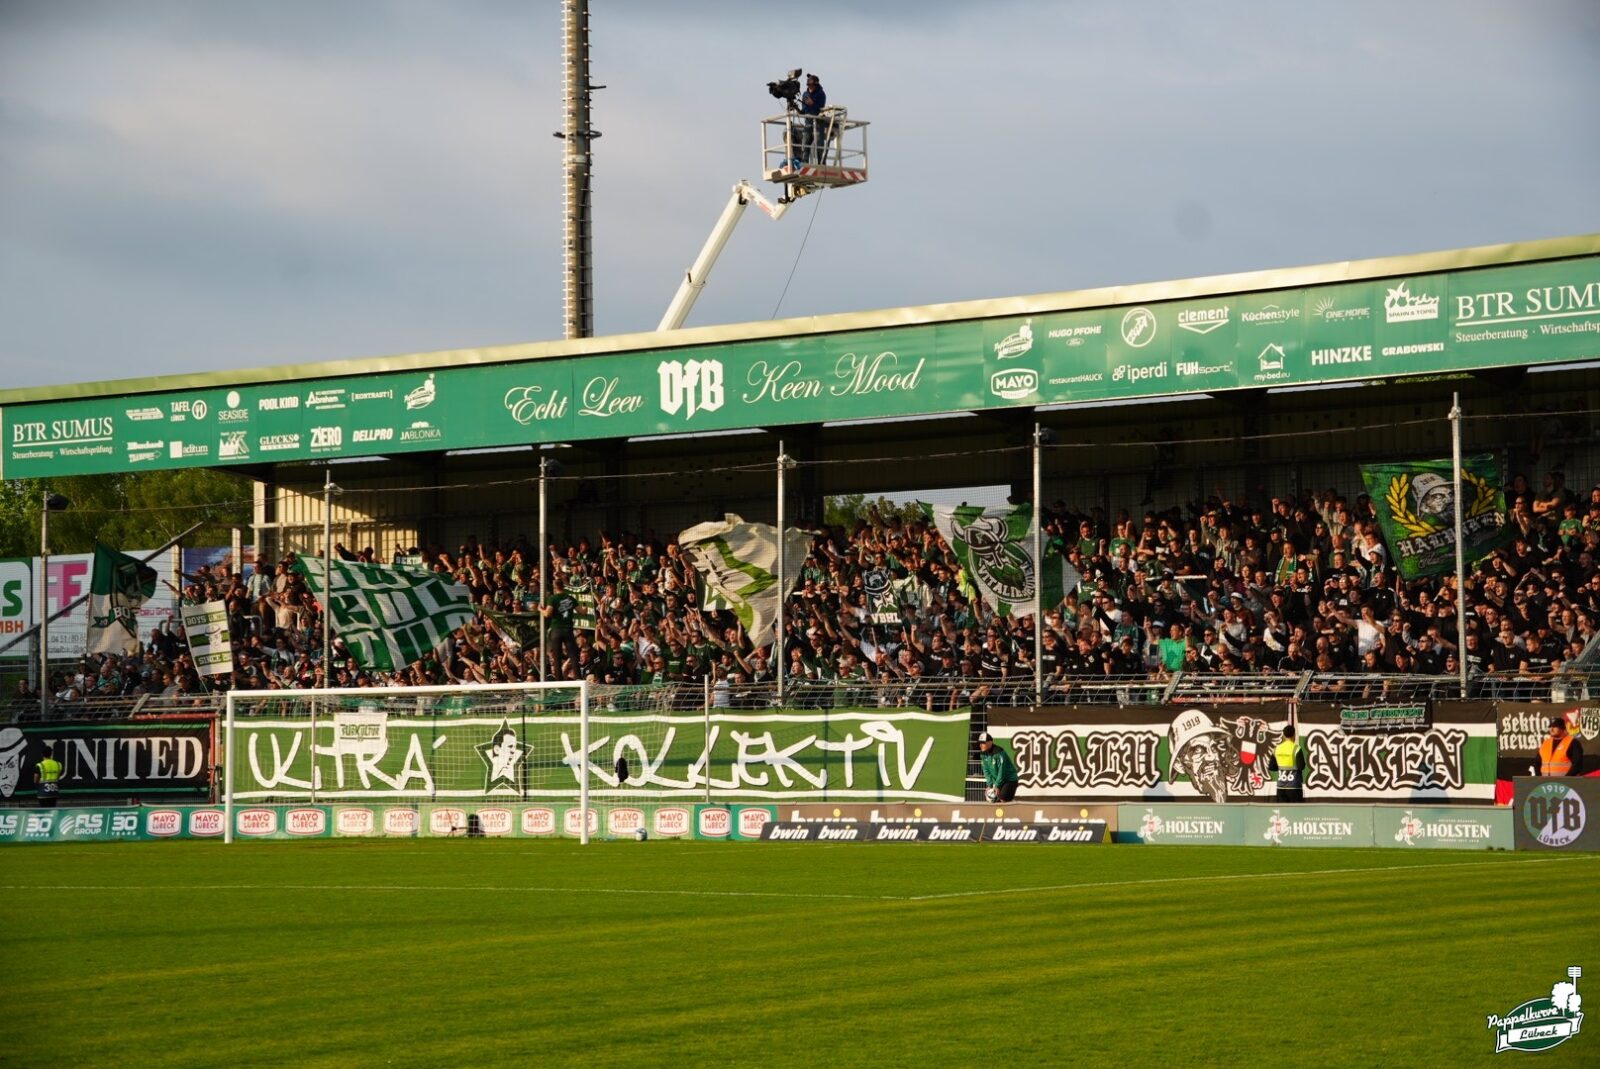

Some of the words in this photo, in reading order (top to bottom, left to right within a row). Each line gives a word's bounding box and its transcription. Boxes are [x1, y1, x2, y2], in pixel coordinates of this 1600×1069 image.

[1456, 292, 1516, 320] BTR
[1526, 283, 1600, 314] SUM
[1178, 306, 1229, 322] clement
[1049, 330, 1072, 338] HUGO
[1455, 329, 1528, 343] Steuerberatung
[1540, 322, 1600, 335] Wirtschaftsp
[1311, 345, 1372, 366] HINZKE
[1382, 343, 1444, 357] GRABOWSKI
[742, 360, 823, 403] Keen
[830, 351, 925, 397] Mood
[1127, 361, 1168, 383] iperdi
[995, 374, 1034, 390] MAYO
[171, 401, 190, 412] TAFEL
[504, 385, 567, 425] Echt
[577, 376, 644, 418] Leev
[218, 409, 248, 420] SEASIDE
[13, 422, 47, 442] BTR
[52, 417, 113, 440] SUMUS
[352, 428, 394, 442] DELLPRO
[400, 429, 441, 440] JABLONKA
[185, 615, 207, 626] BOYS
[1182, 716, 1201, 731] 1919
[1502, 712, 1550, 733] sektio
[43, 736, 203, 780] UNITED
[1542, 784, 1565, 793] 1919
[0, 815, 18, 829] LS
[75, 814, 103, 828] FLS
[112, 816, 138, 831] 30
[153, 814, 175, 822] MAYO
[195, 814, 219, 822] MAYO
[244, 814, 270, 822] MAYO
[292, 813, 318, 821] MAYO
[26, 818, 52, 832] 30
[744, 821, 761, 829] LÜBEC
[769, 825, 809, 839] bwin
[818, 825, 858, 839] bwin
[1166, 820, 1223, 834] HOLSTEN
[1293, 822, 1352, 835] HOLSTEN
[1426, 823, 1490, 838] HOLSTEN
[877, 825, 918, 840] bwin
[928, 825, 971, 840] bwin
[992, 825, 1037, 840] bwin
[1048, 825, 1093, 841] bwin
[1538, 834, 1570, 845] LÜBECK
